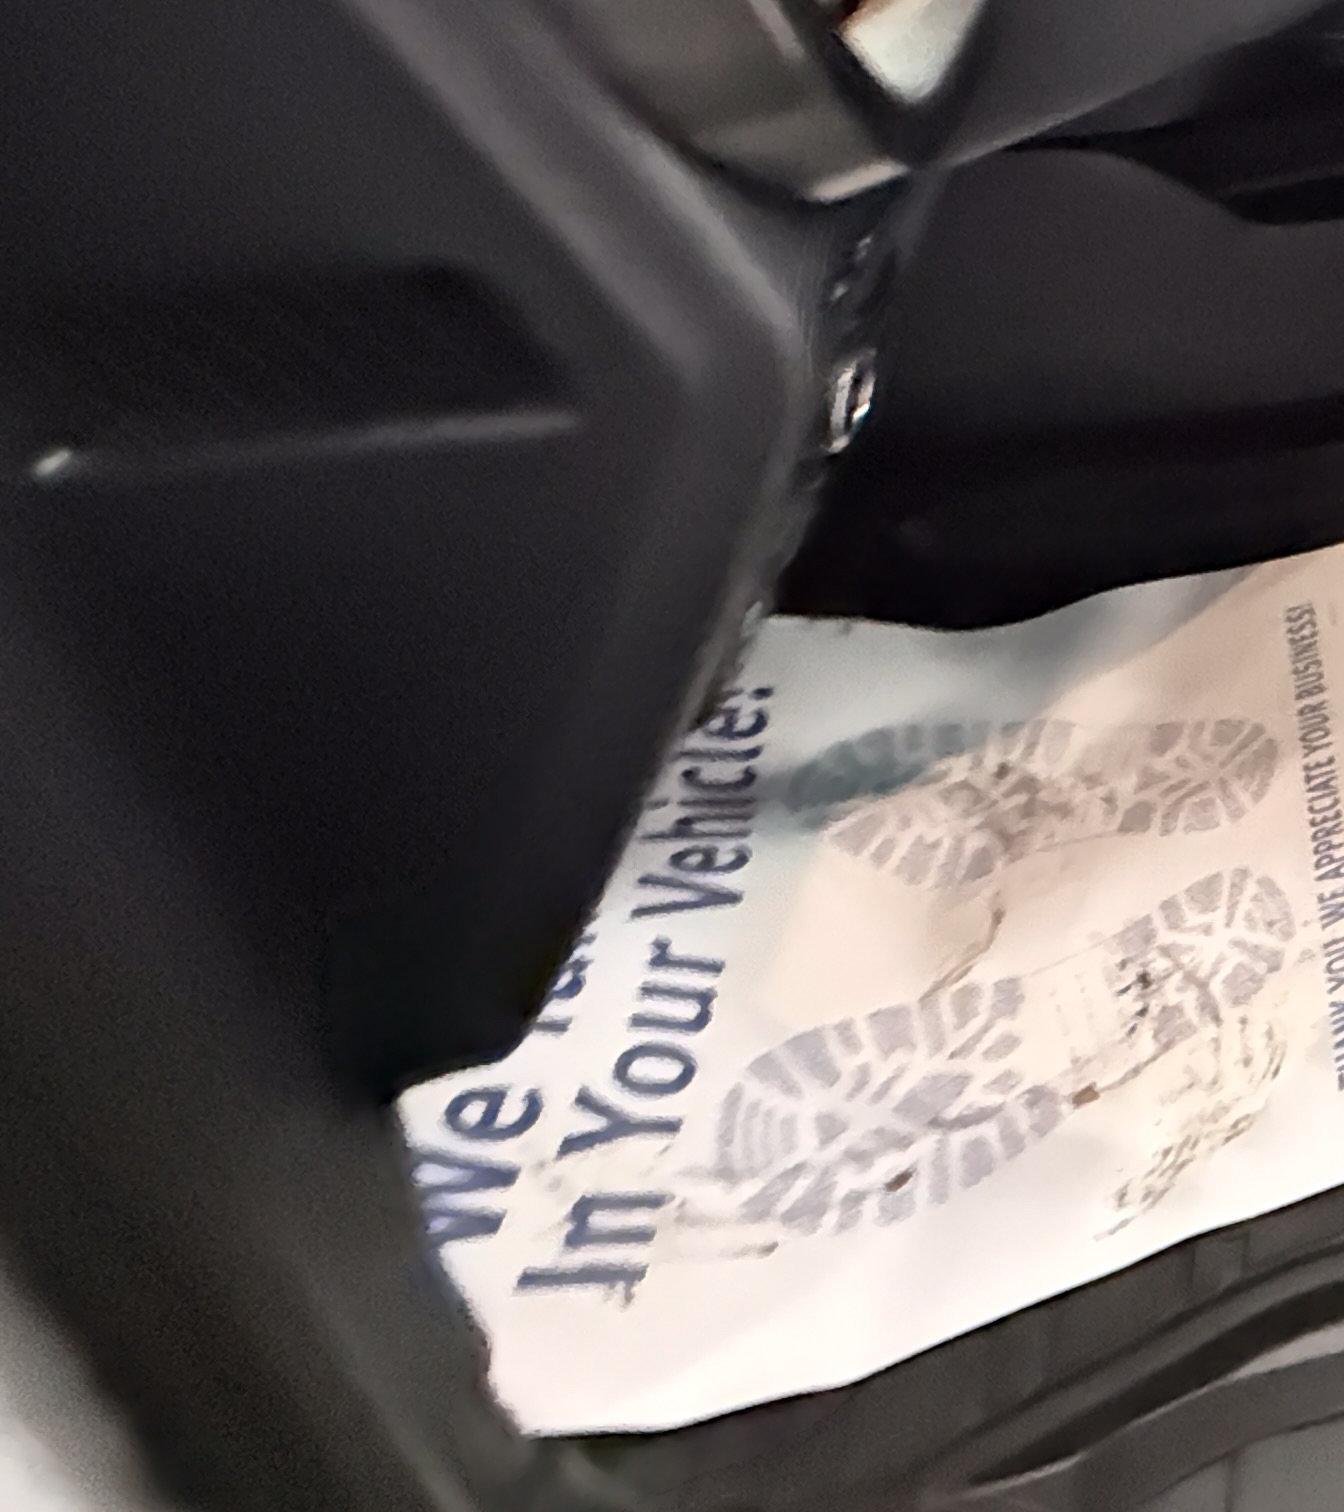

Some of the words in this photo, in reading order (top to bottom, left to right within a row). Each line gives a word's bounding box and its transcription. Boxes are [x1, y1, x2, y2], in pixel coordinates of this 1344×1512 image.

[1286, 602, 1328, 700] BUSINESS!
[1297, 700, 1333, 758] YOUR
[556, 936, 727, 1162] Your
[407, 1087, 543, 1248] We
[514, 1190, 676, 1298] In
